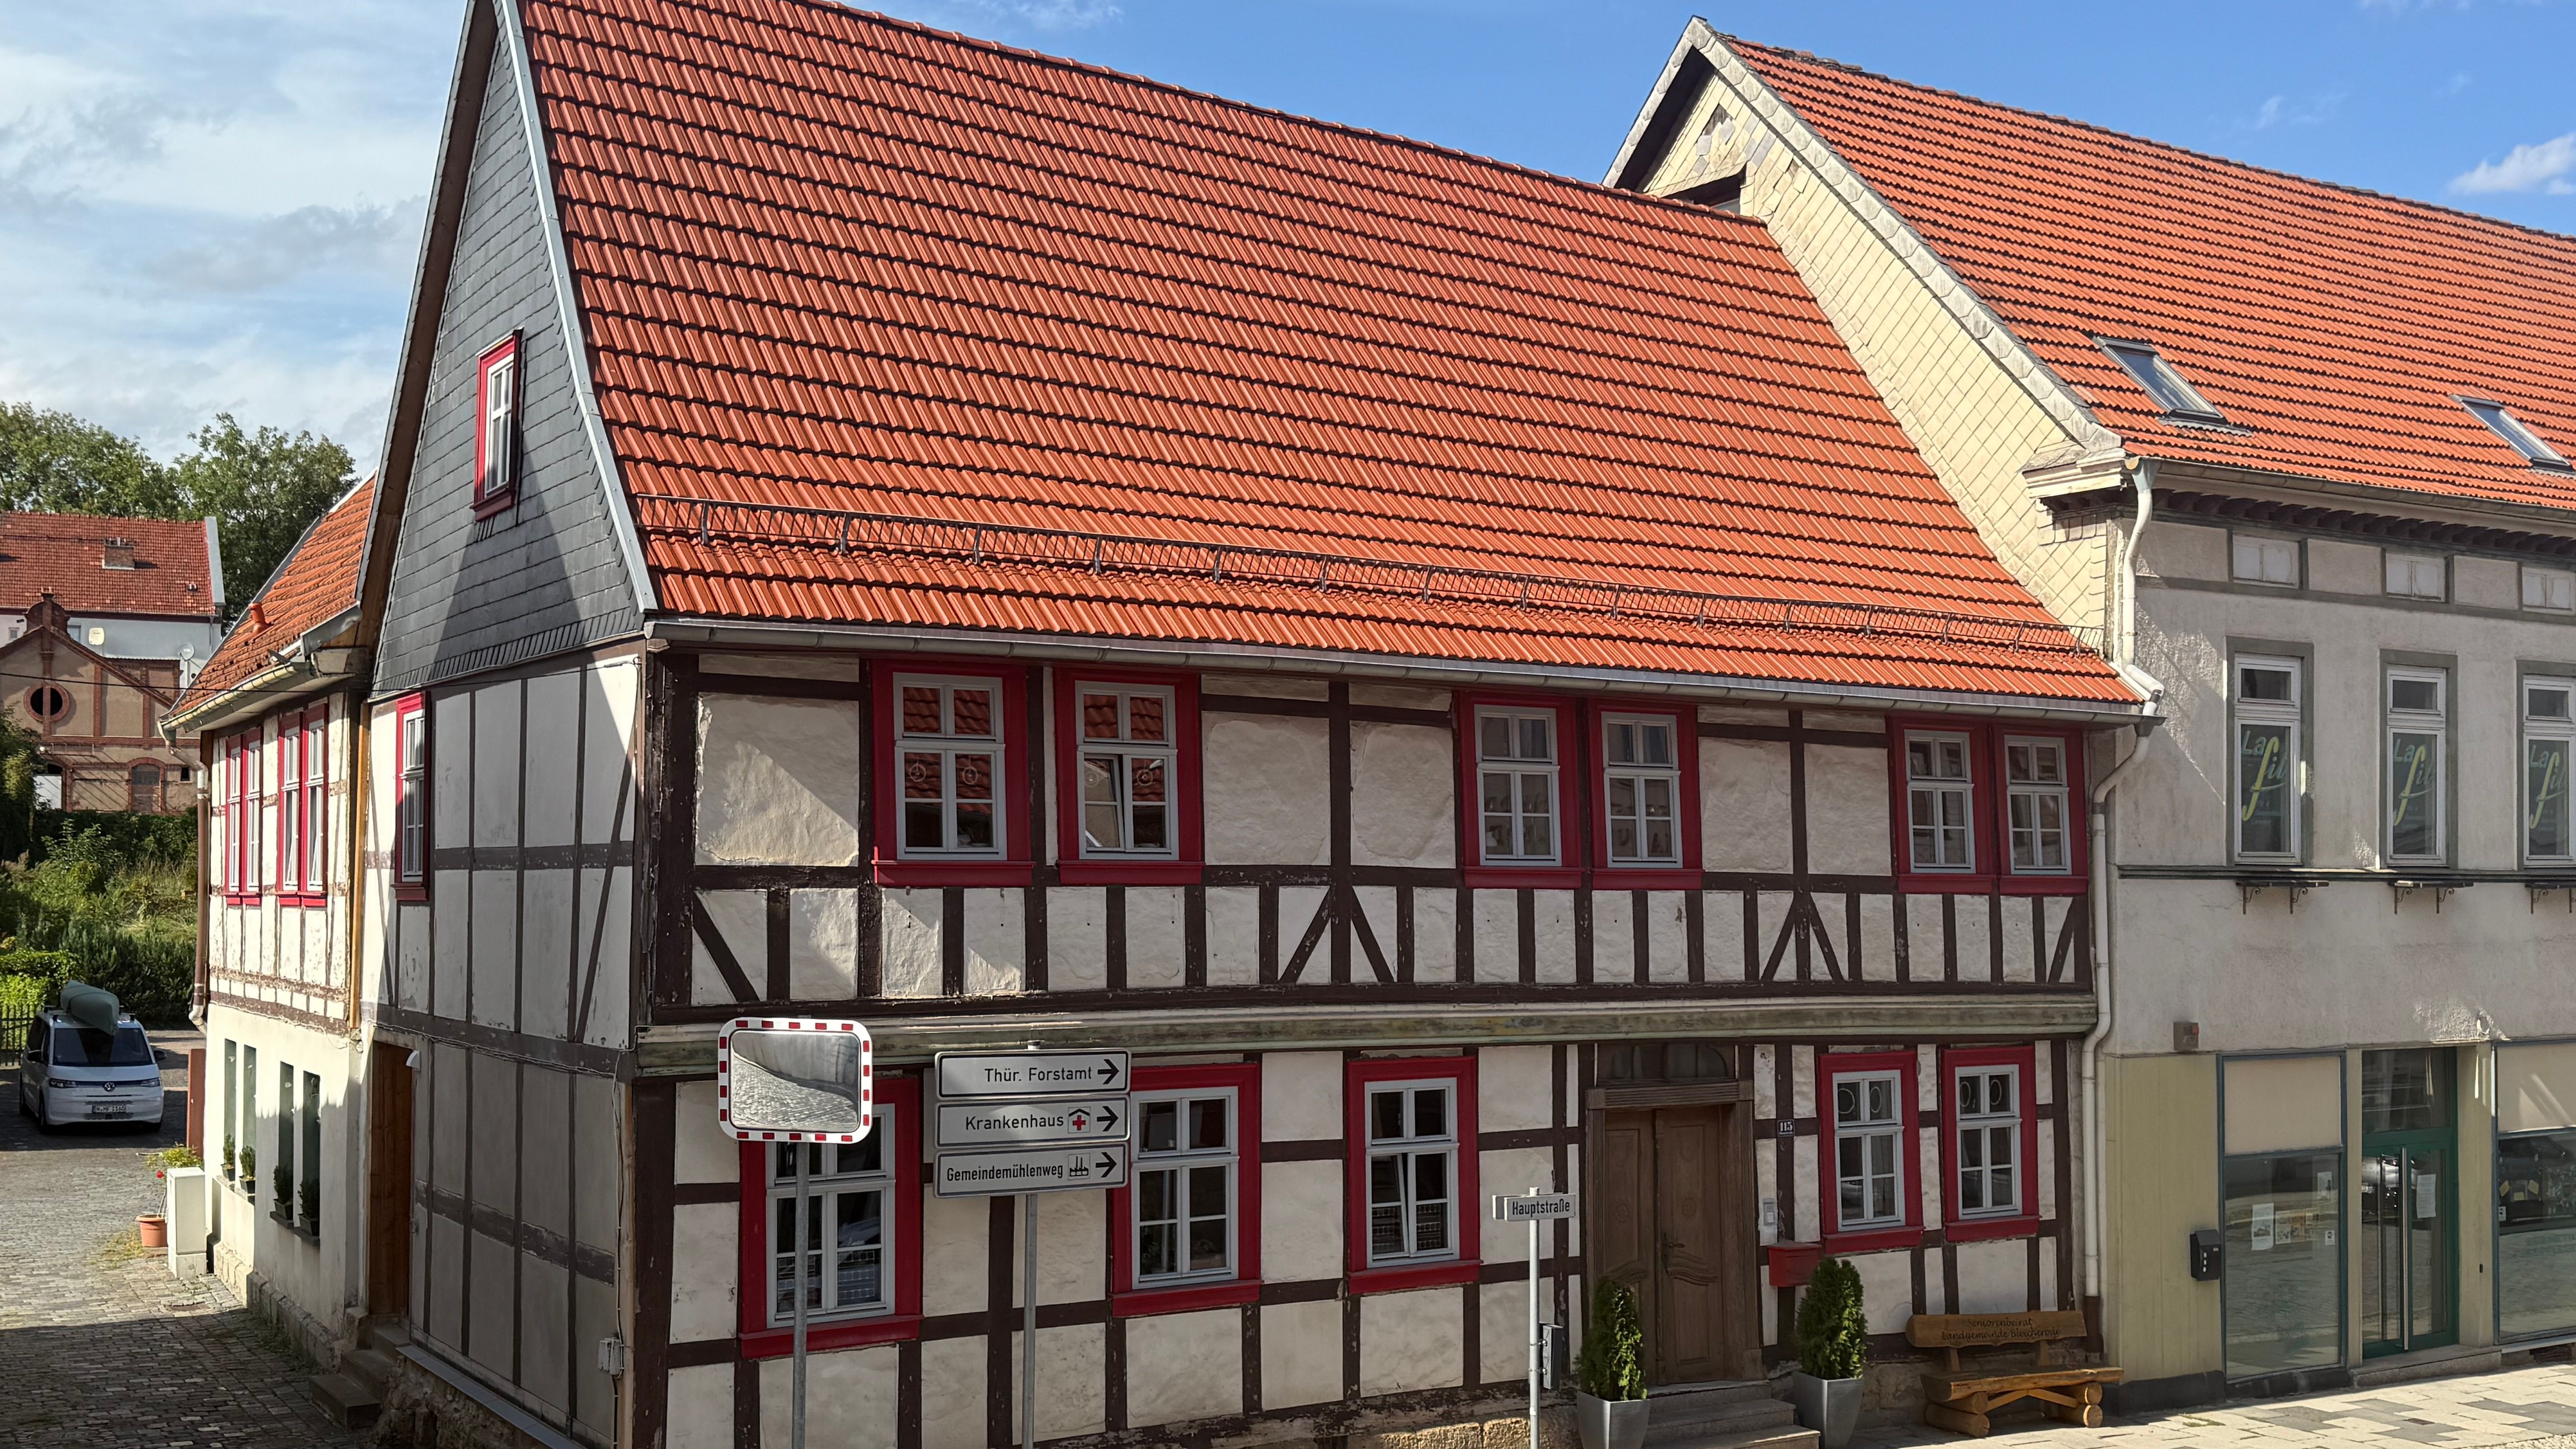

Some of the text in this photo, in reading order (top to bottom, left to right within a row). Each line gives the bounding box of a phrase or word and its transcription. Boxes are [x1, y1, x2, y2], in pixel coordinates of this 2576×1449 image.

[984, 1066, 1092, 1082] Thür. Forstamt
[966, 1114, 1064, 1131] Krankenhaus
[1780, 1121, 1793, 1132] 115
[947, 1164, 1063, 1182] Gemeindemühlenweg
[1512, 1199, 1570, 1218] Hauptstraße
[1942, 1329, 2008, 1342] Landgemeinde
